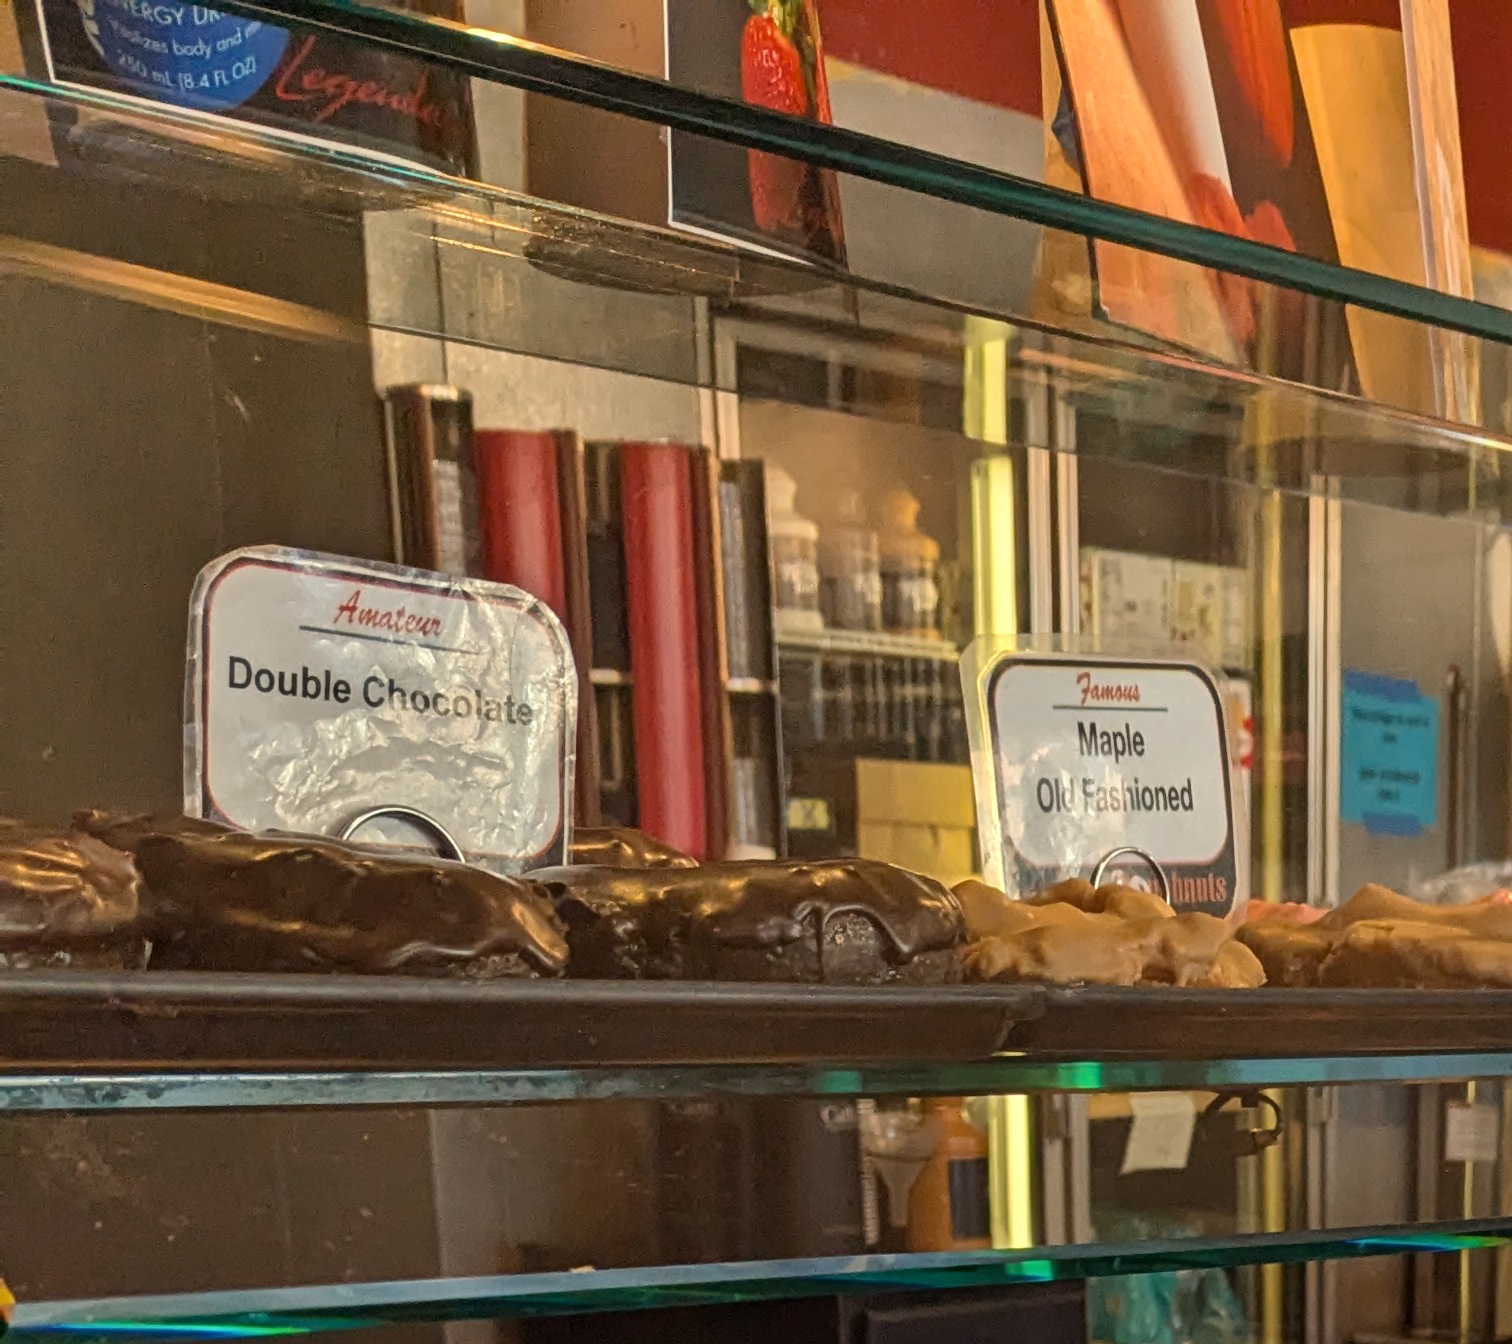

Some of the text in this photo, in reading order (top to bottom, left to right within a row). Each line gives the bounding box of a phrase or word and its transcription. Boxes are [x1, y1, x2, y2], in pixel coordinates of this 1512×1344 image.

[333, 589, 443, 638] Amateur
[228, 655, 533, 726] Double Chocolate
[1076, 671, 1141, 706] Famous
[1077, 721, 1145, 765] Maple
[1036, 776, 1194, 814] Old Fashioned
